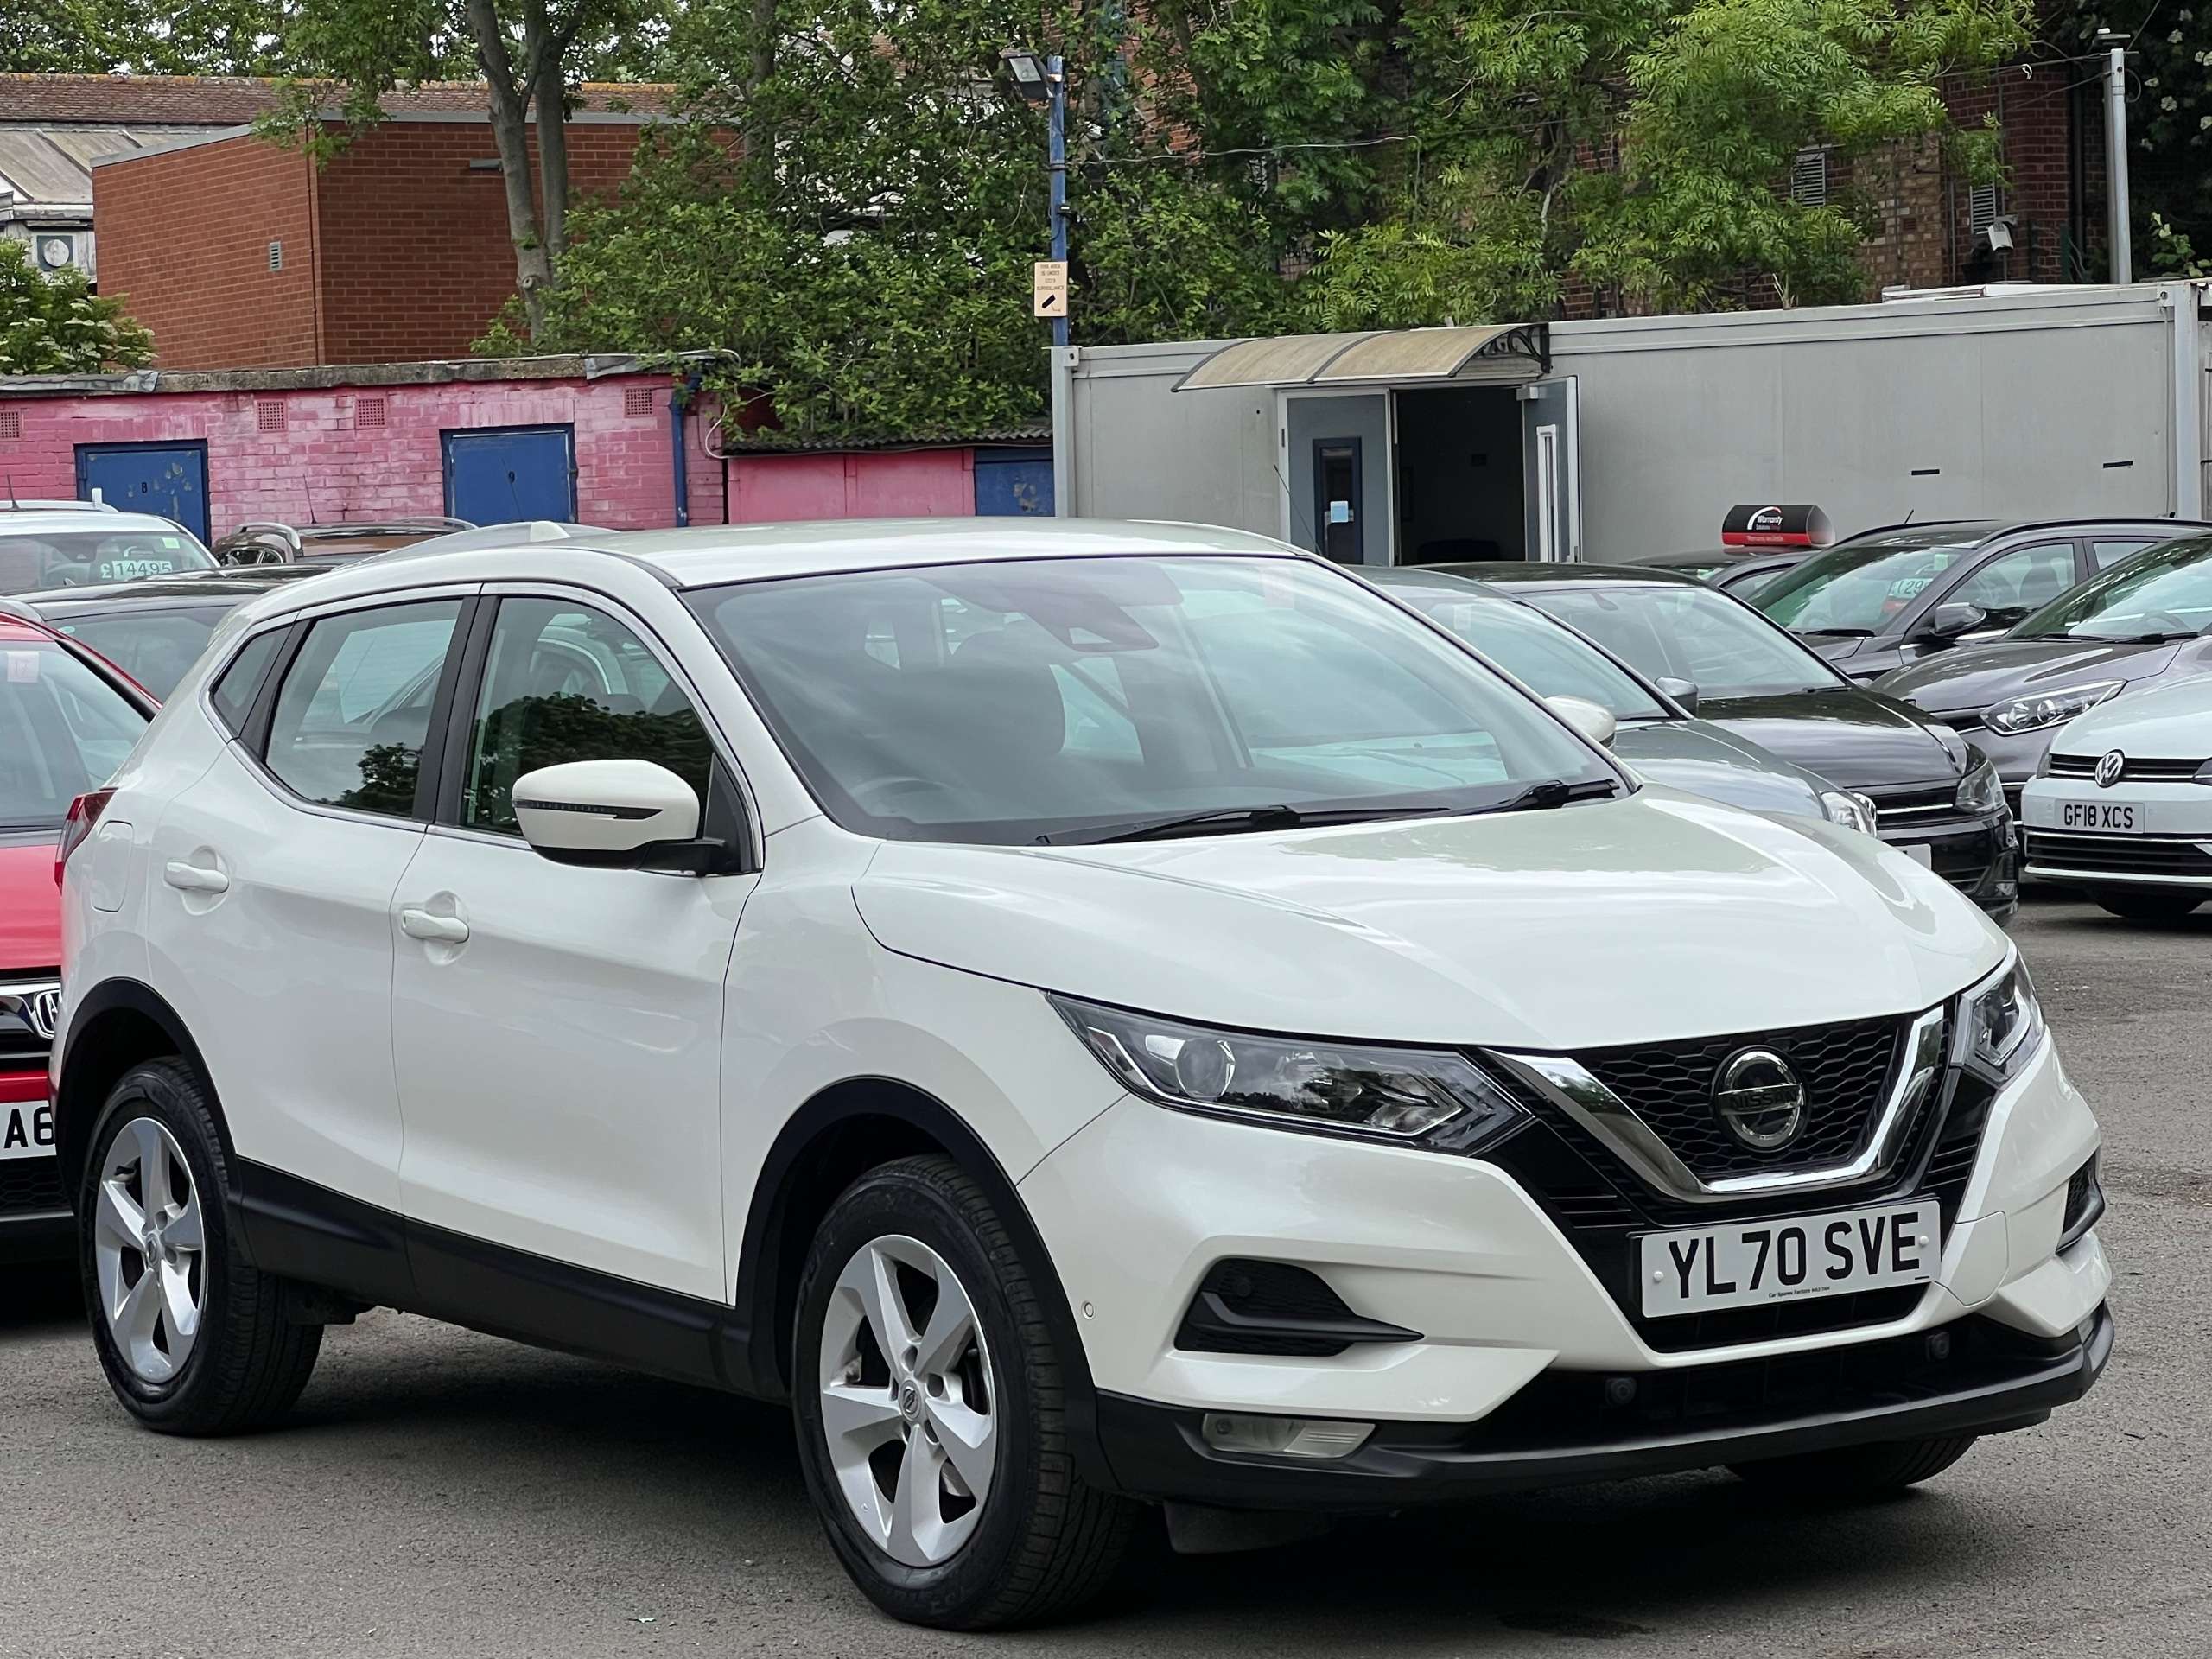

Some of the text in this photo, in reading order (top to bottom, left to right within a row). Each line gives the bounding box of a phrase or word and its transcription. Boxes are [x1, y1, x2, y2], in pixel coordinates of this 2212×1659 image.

[508, 470, 515, 484] 9
[2063, 804, 2133, 830] GF18 XCS
[1729, 1090, 1797, 1109] NISSAN
[1668, 1211, 1920, 1299] YL70 SVE
